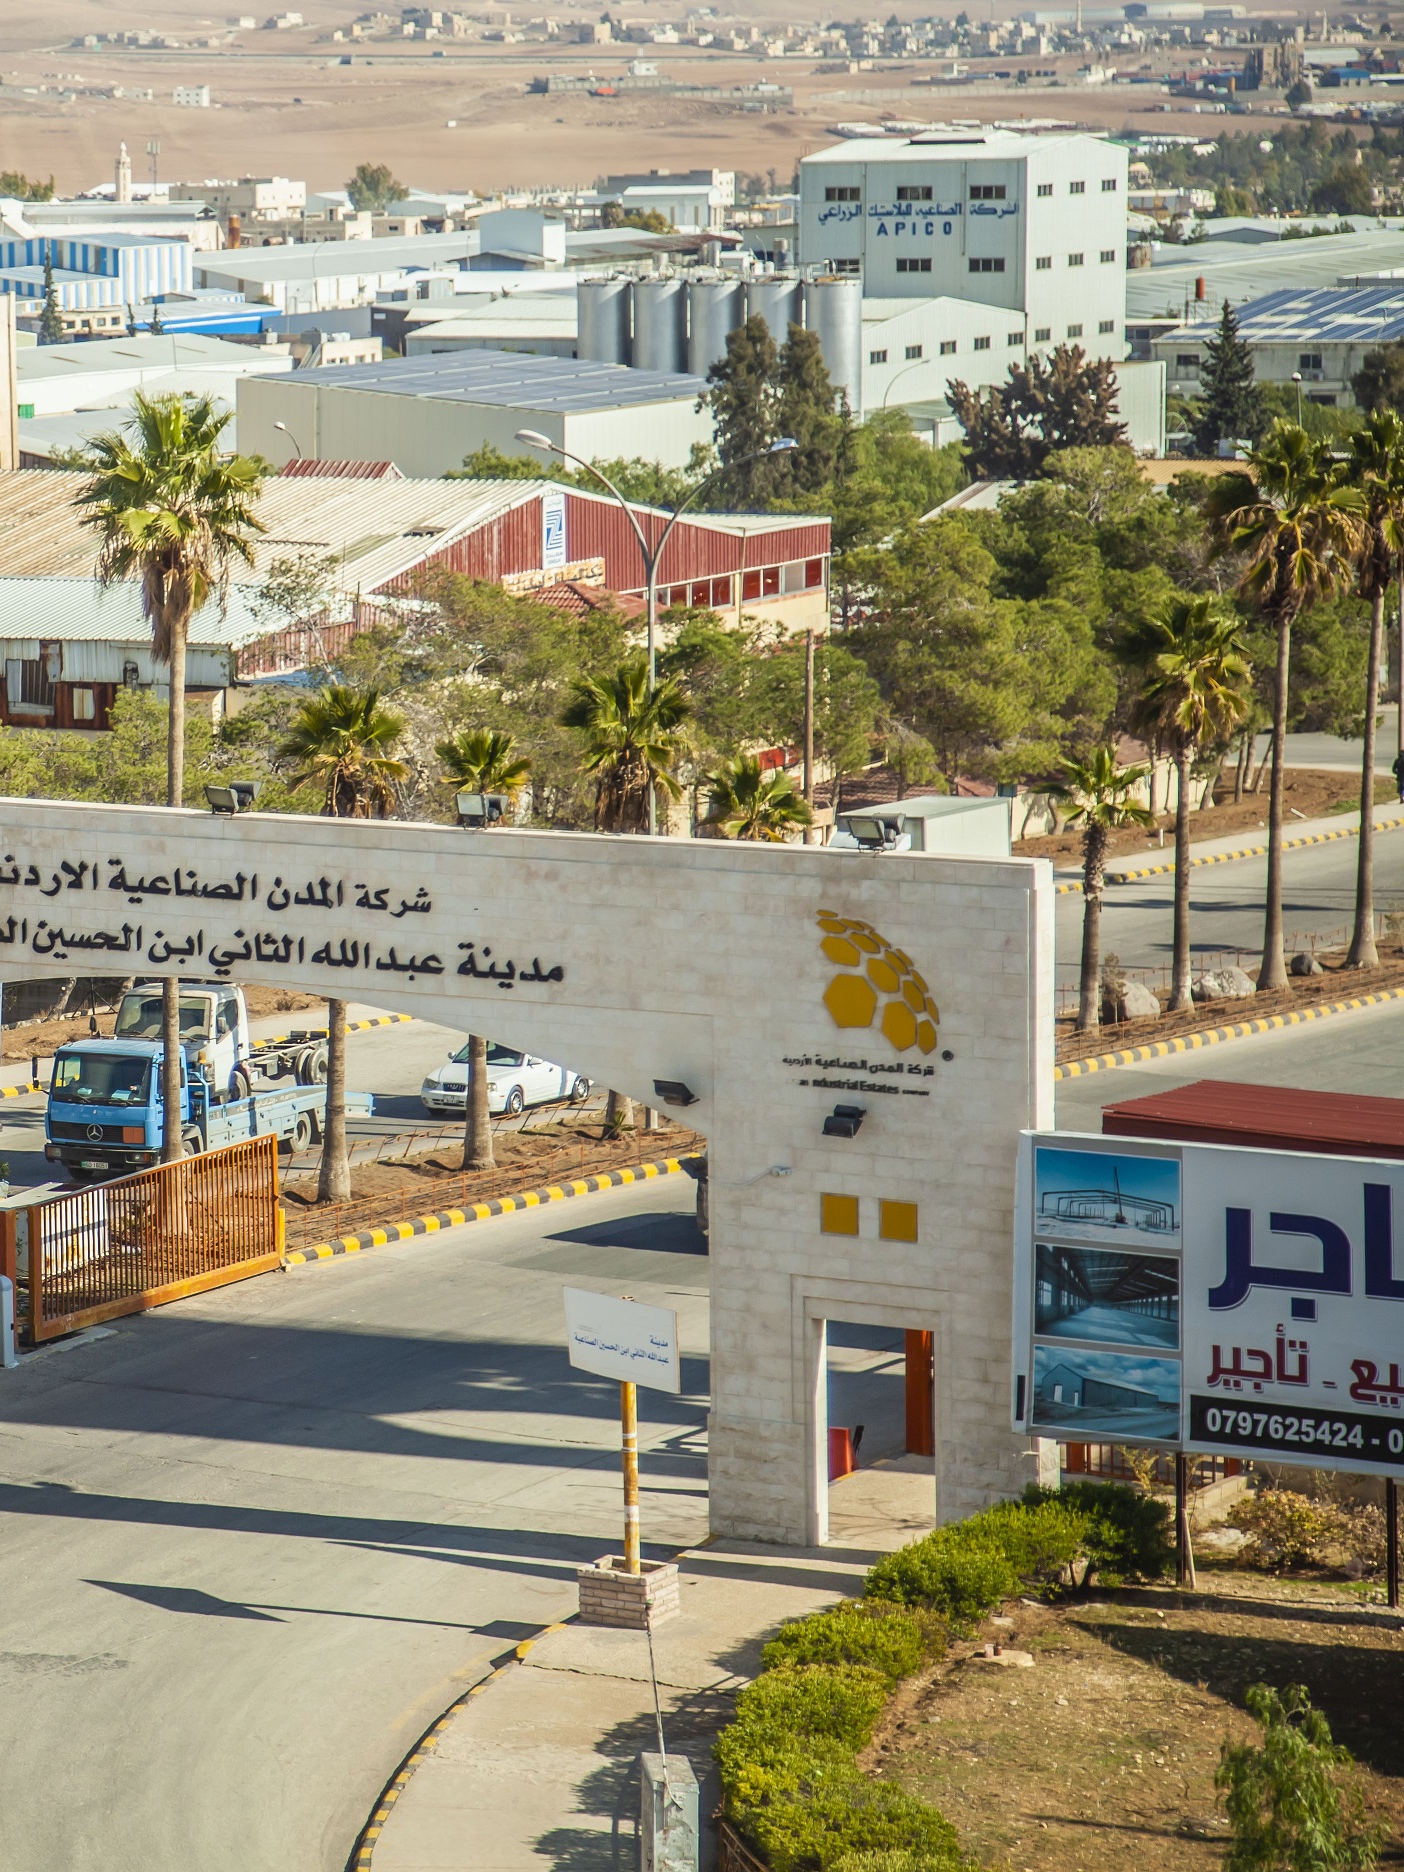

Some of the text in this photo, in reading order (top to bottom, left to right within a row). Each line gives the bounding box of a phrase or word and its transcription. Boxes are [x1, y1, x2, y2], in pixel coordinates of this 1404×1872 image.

[876, 221, 952, 236] APICO
[108, 857, 258, 904] الصناعية
[267, 876, 344, 911] المدن
[354, 883, 432, 918] شركة
[32, 919, 142, 960] الحسين
[148, 929, 203, 964] ابن
[208, 929, 304, 976] الثاني
[457, 942, 564, 989] مدينة
[1207, 1323, 1310, 1392] تأجير
[1206, 1407, 1364, 1449] 0797625424
